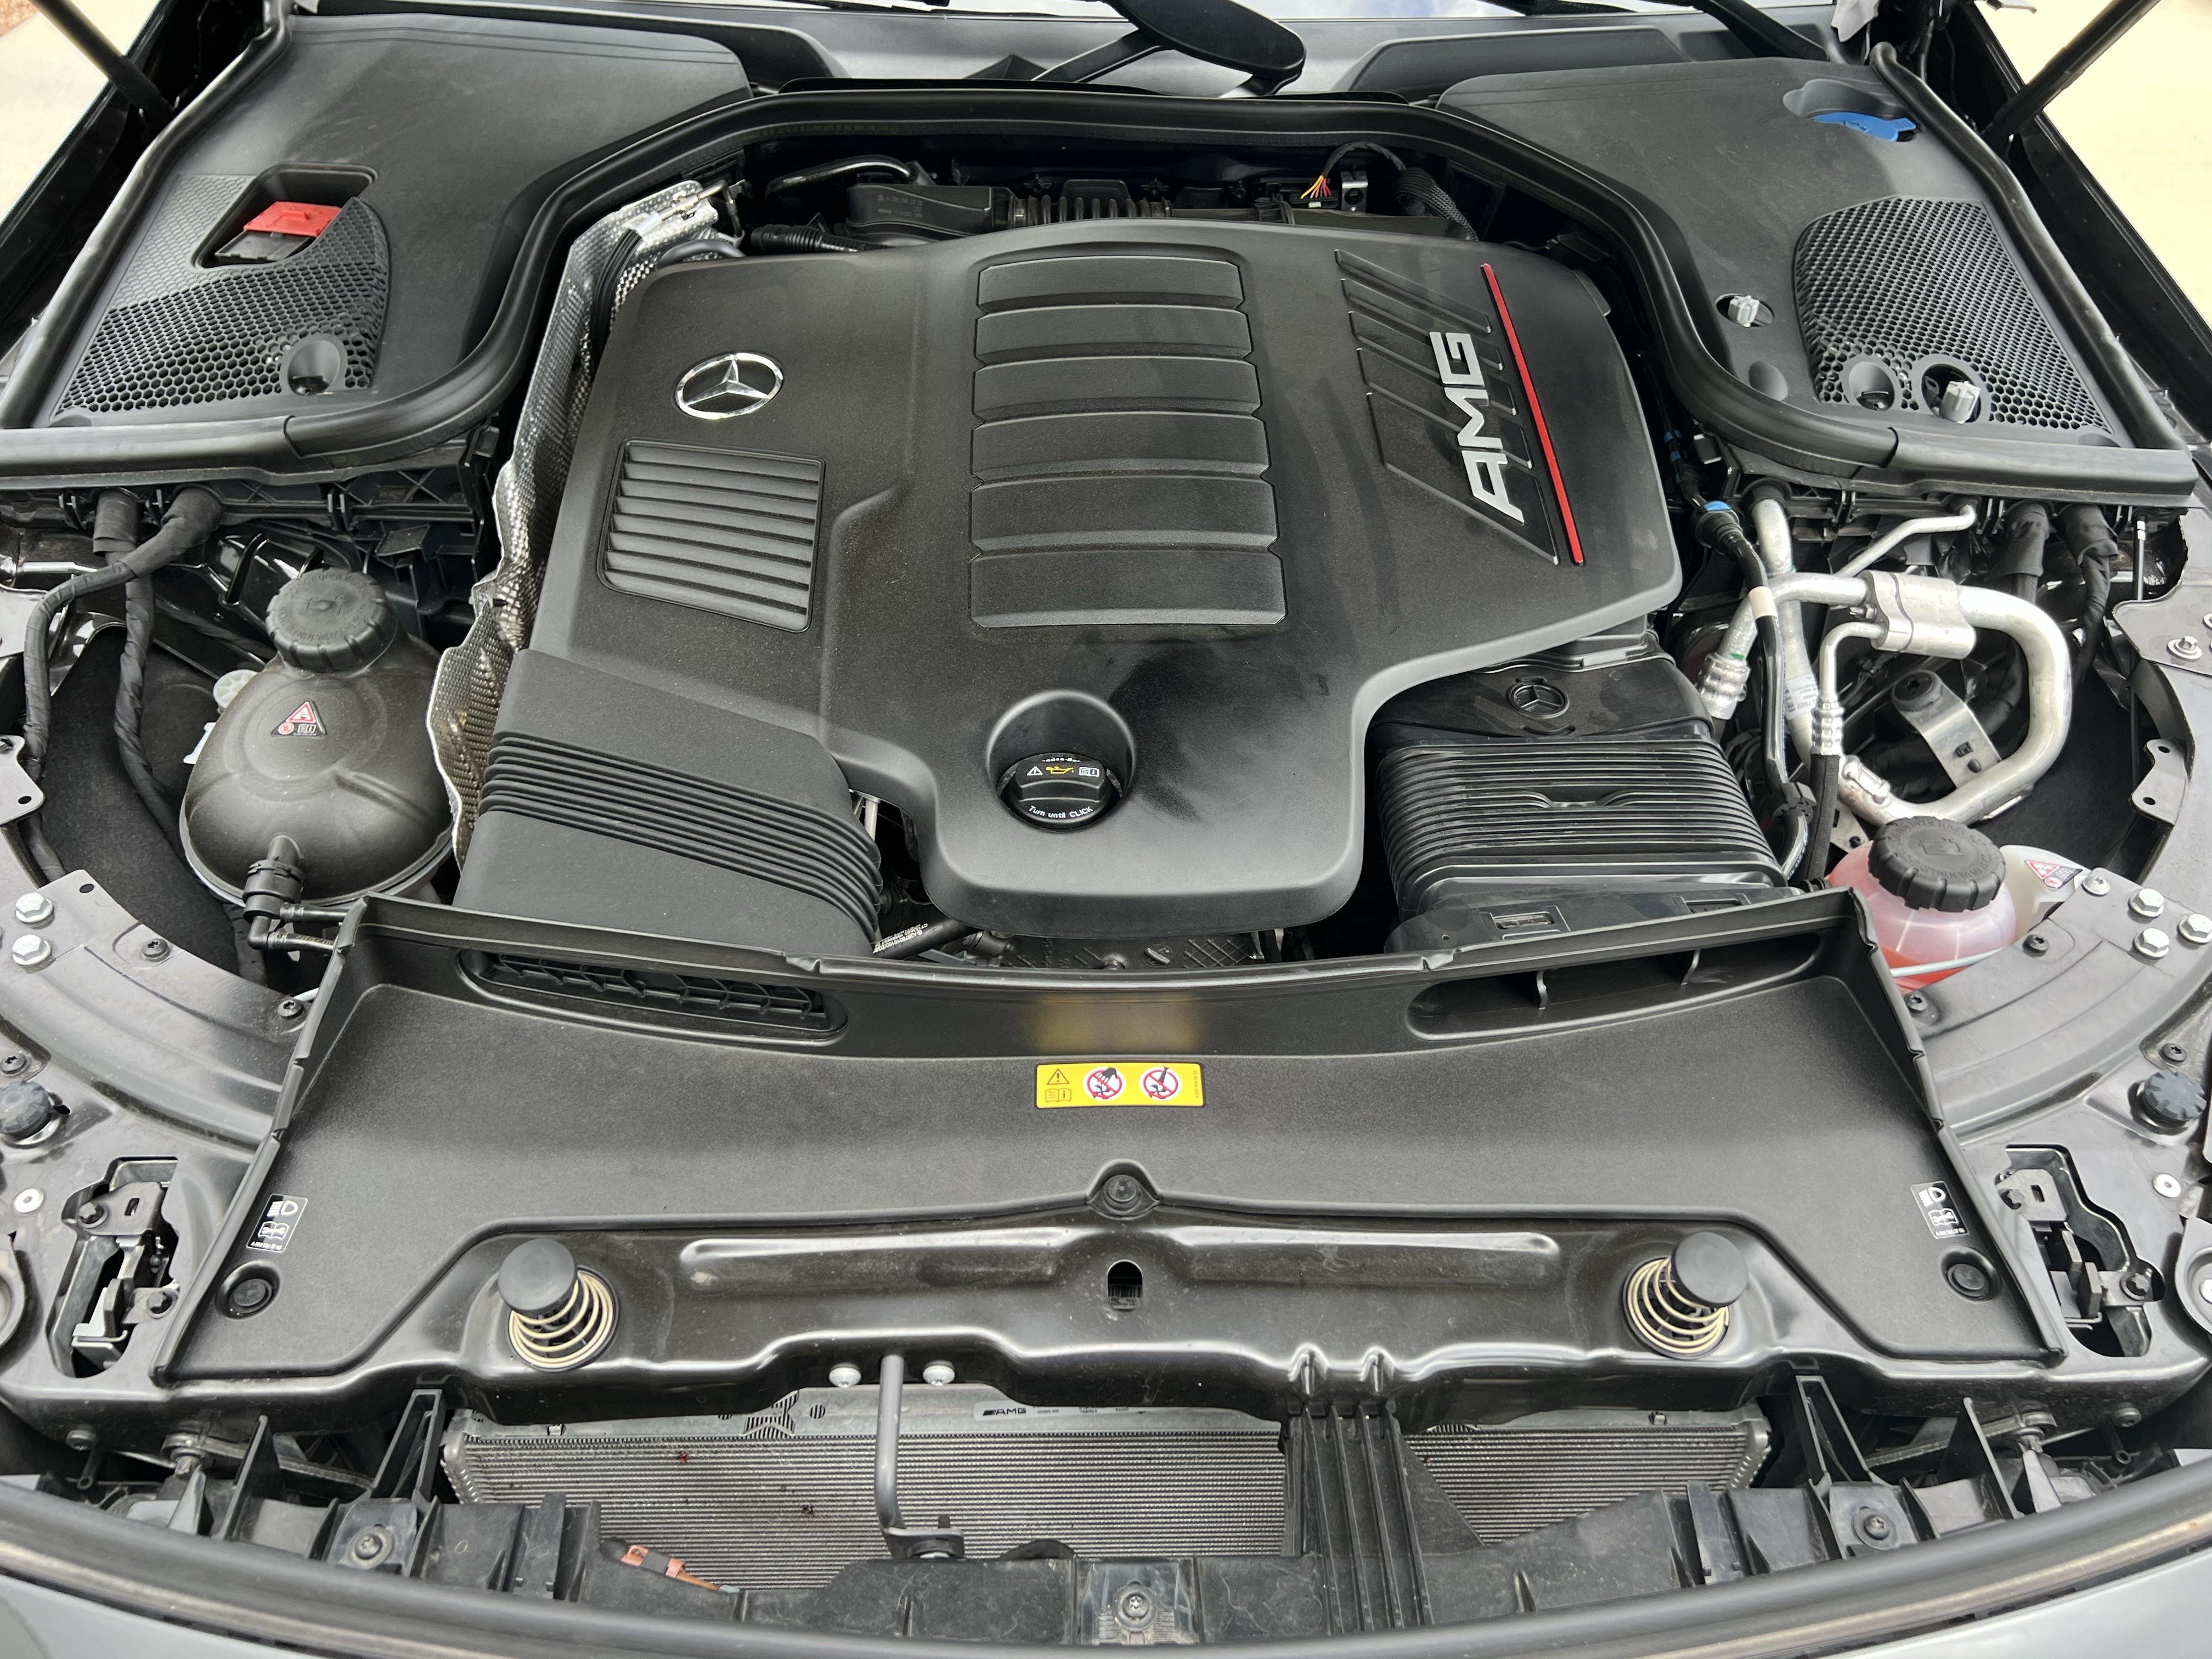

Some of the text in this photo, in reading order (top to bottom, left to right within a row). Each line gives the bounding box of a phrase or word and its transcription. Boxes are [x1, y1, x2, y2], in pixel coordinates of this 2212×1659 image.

[1429, 331, 1525, 524] AMG
[1029, 805, 1046, 816] Turn
[1069, 806, 1093, 817] CLICK
[995, 1407, 1026, 1415] AMG
